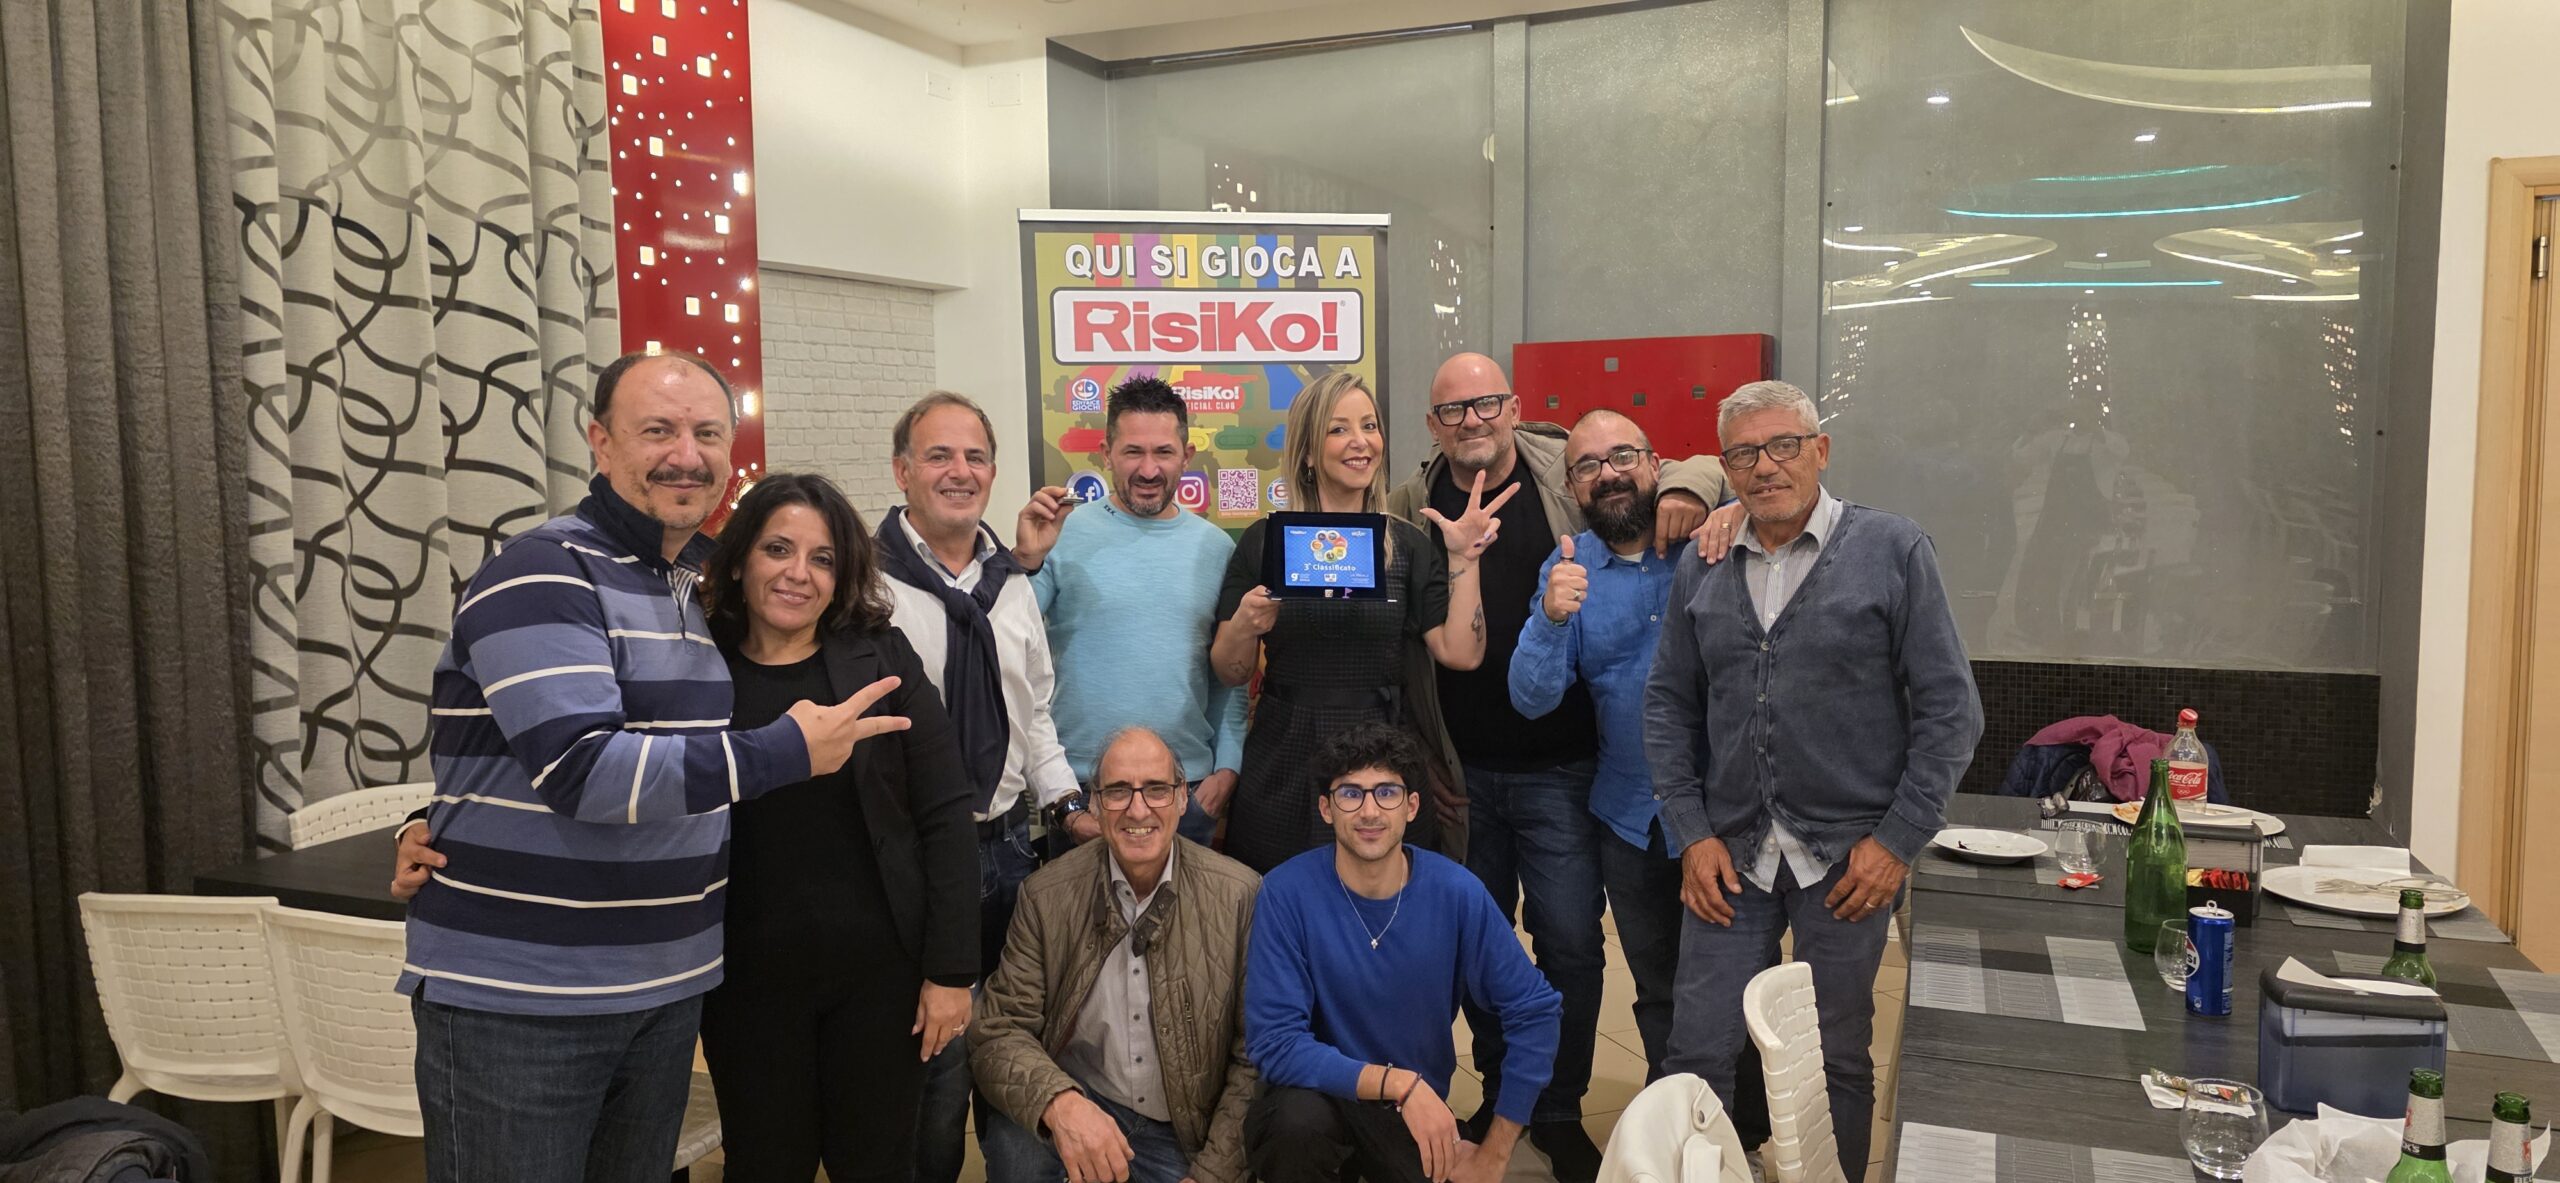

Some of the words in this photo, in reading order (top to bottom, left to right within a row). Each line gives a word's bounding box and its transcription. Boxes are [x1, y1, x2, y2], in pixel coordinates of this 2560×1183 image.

[1065, 244, 1135, 279] QUI
[1150, 245, 1188, 278] SI
[1201, 245, 1325, 278] GIOCA
[1334, 246, 1361, 278] A
[1072, 300, 1339, 353] RisiKo!
[1215, 402, 1236, 411] CLUB
[1312, 563, 1357, 572] Classificato
